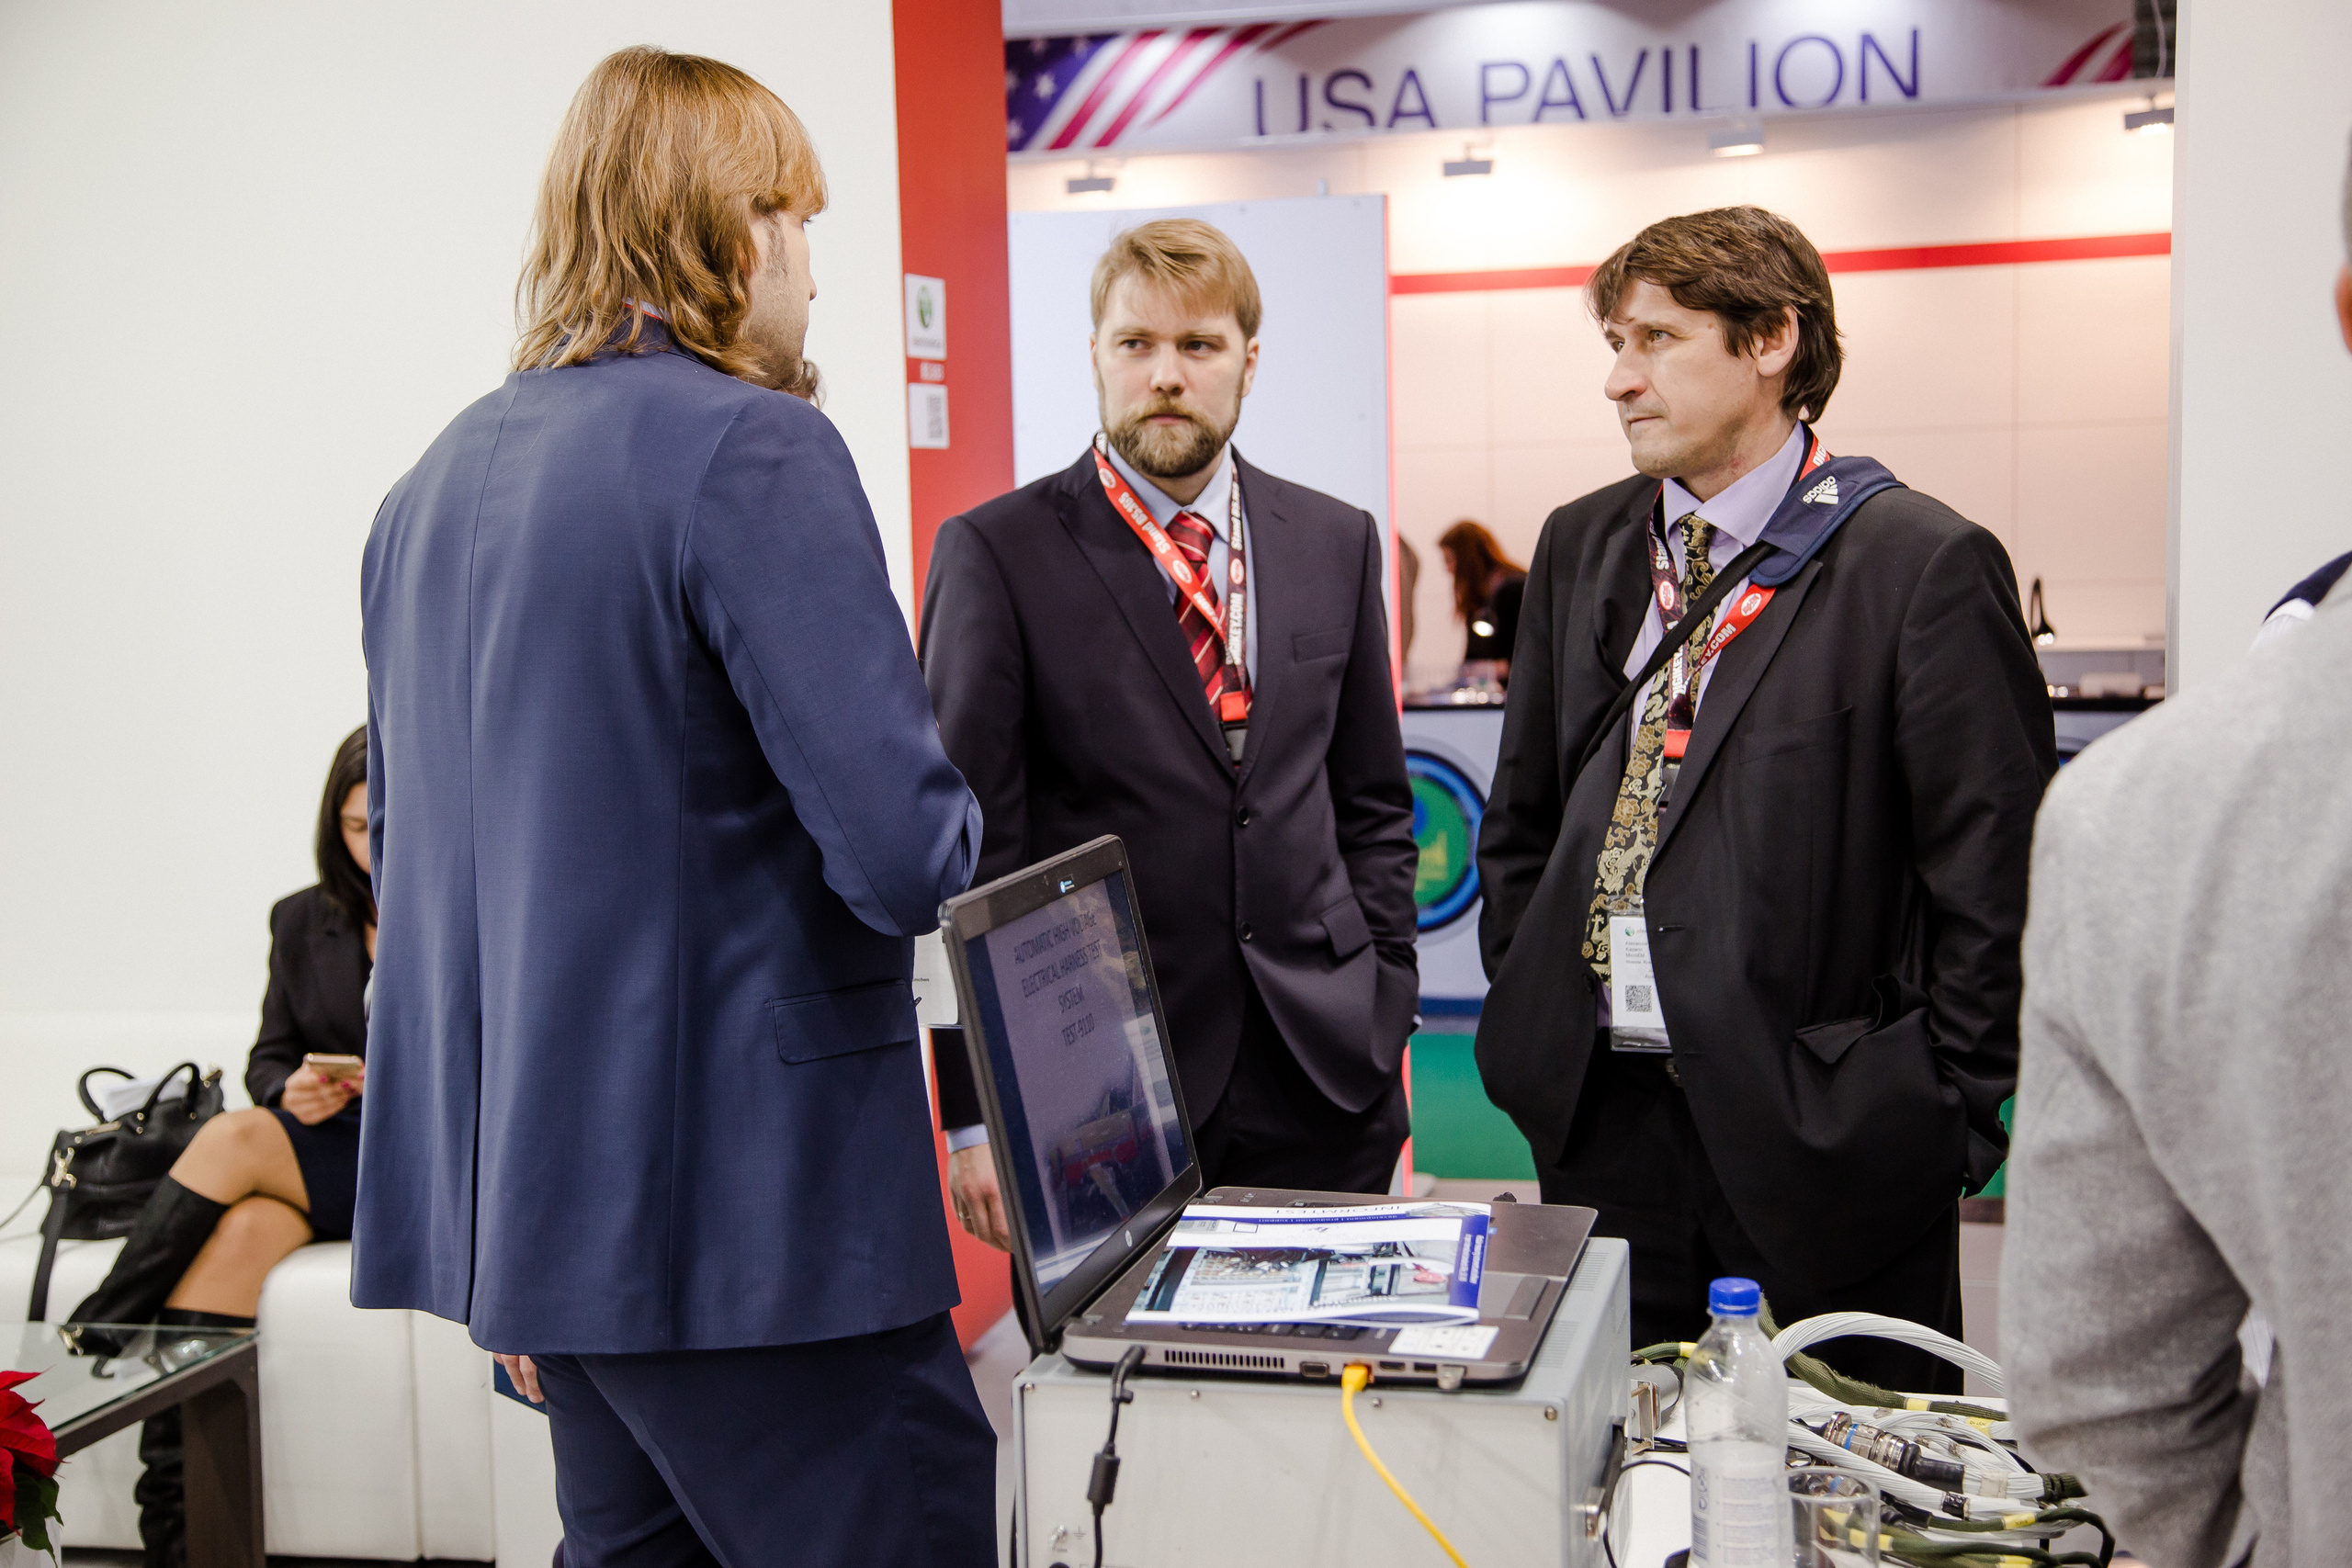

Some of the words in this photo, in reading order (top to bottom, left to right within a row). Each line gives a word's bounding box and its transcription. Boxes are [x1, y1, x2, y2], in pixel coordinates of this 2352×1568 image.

[1254, 66, 1436, 136] USA
[1479, 27, 1919, 124] PAVILION
[1803, 476, 1837, 504] adidas
[1118, 491, 1148, 526] B5.165
[1142, 521, 1171, 554] Stand
[1230, 516, 1243, 551] Stand
[1014, 929, 1054, 964] AUTOMATIC
[1052, 924, 1070, 945] HIGH
[1021, 964, 1060, 998] ELECTRICAL
[1059, 946, 1089, 977] HARNESS
[1088, 939, 1102, 960] TEST
[1058, 984, 1085, 1014] SYSTEM
